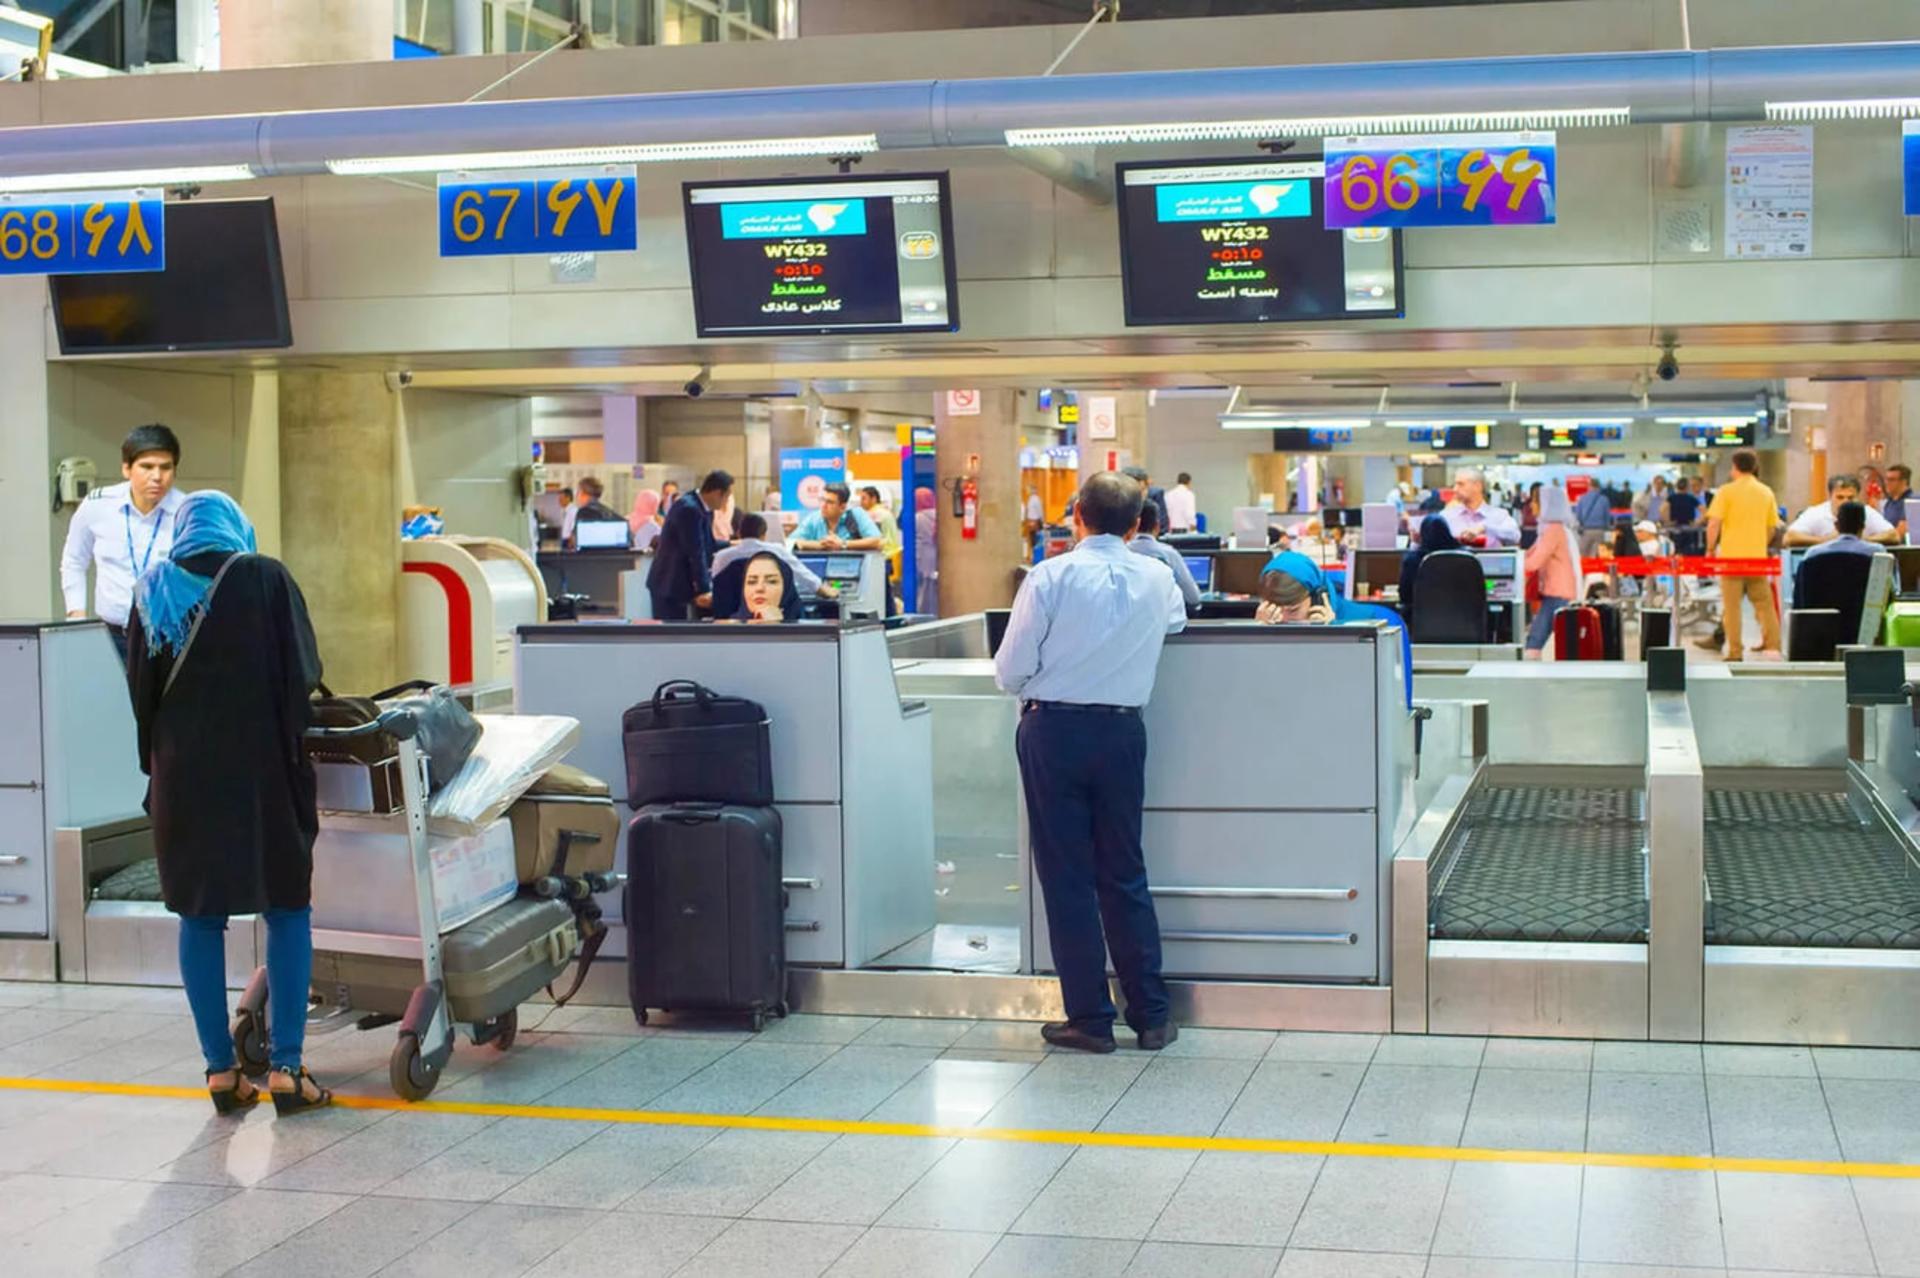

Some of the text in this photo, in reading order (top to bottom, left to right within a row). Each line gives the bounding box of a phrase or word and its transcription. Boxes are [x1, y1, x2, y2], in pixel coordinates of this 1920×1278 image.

[1342, 156, 1420, 211] 66
[1457, 149, 1543, 211] ۶۶
[0, 204, 59, 259] 68
[84, 201, 152, 257] ۶۸
[453, 191, 519, 241] 67
[548, 180, 623, 236] ۶۷
[1201, 226, 1270, 242] WY432
[763, 242, 829, 258] WY432
[1206, 267, 1267, 281] مسقط
[770, 281, 828, 296] مسقط
